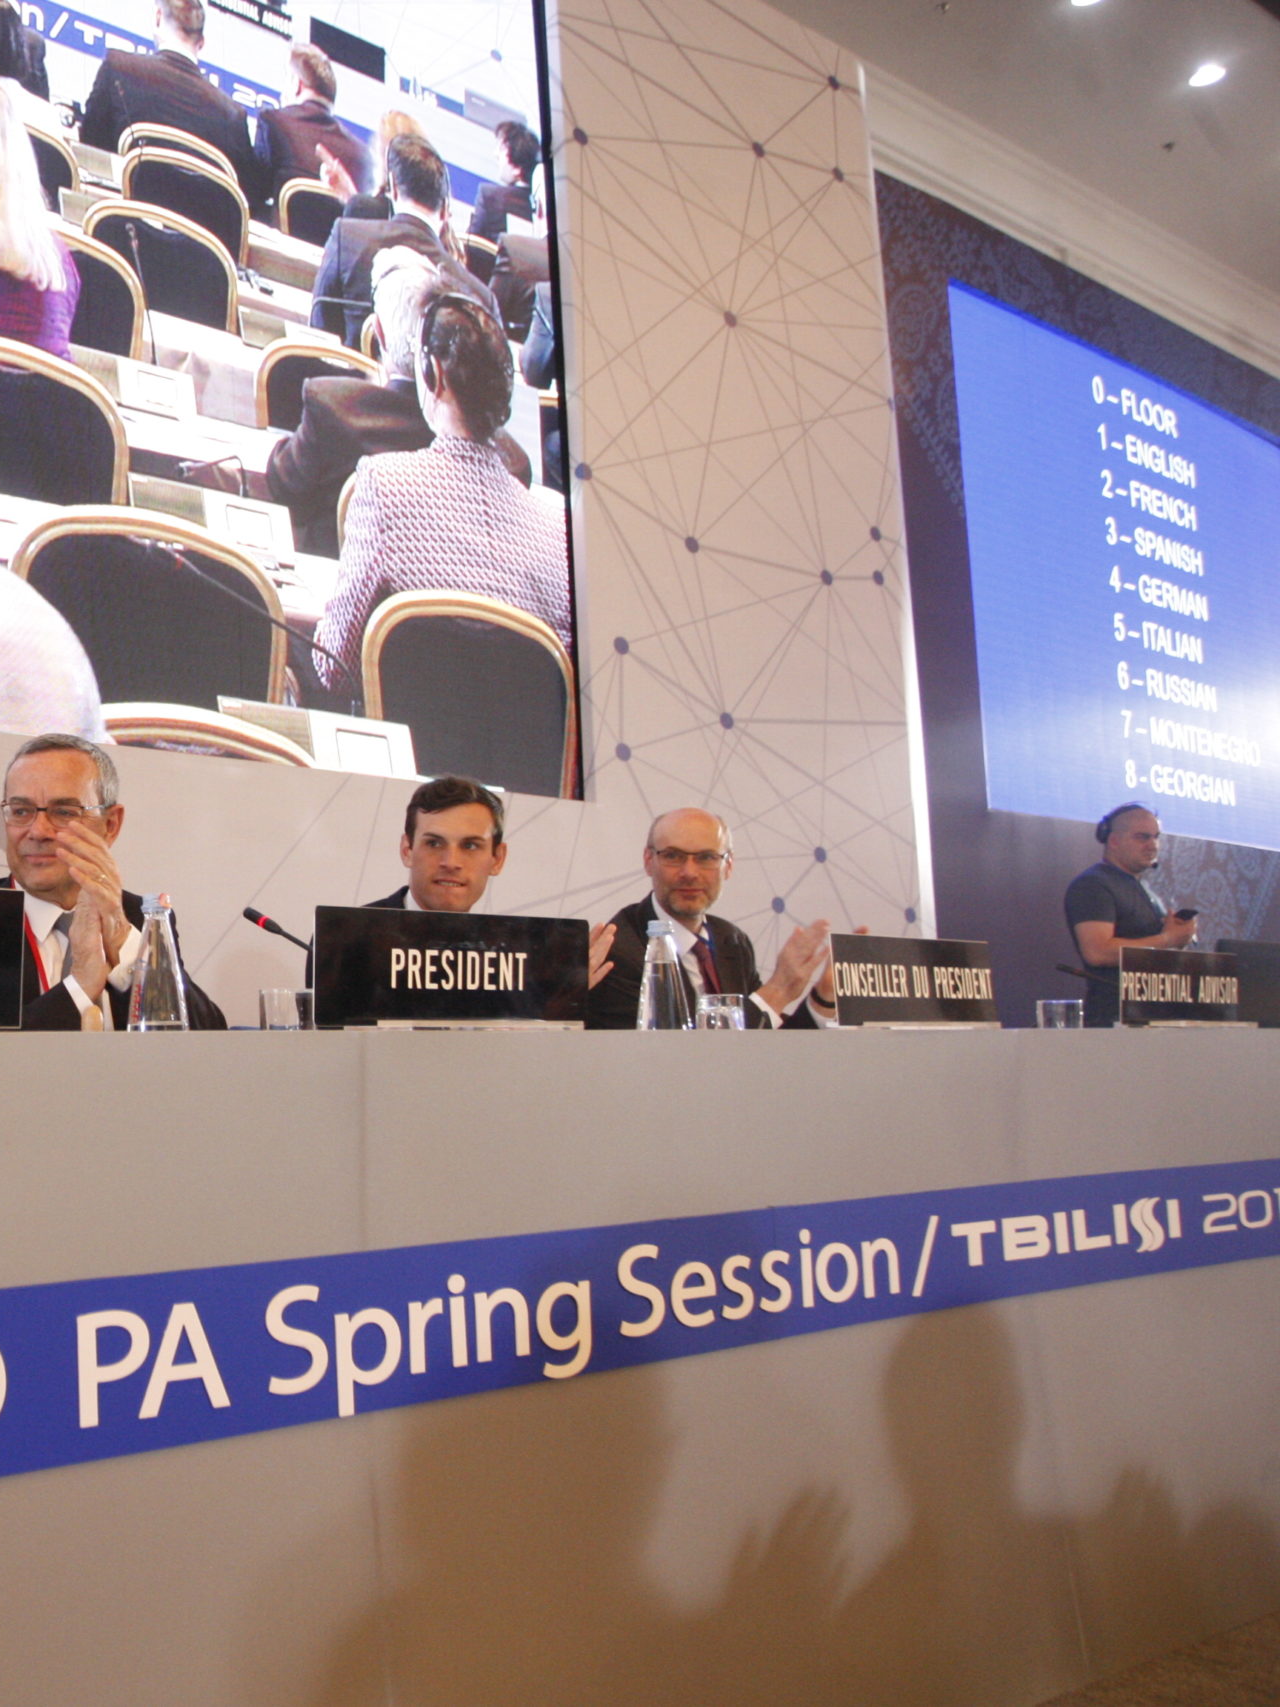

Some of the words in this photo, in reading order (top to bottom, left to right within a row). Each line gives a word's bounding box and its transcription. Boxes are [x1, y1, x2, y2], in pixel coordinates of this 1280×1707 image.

[1121, 388, 1178, 439] FLOOR
[1125, 434, 1196, 489] ENGLISH
[1129, 480, 1198, 532] FRENCH
[1134, 527, 1204, 577] SPANISH
[1138, 574, 1209, 622] GERMAN
[1141, 620, 1204, 665] ITALIAN
[1145, 667, 1219, 713] RUSSIAN
[1150, 716, 1262, 768] MONTENEGRO
[1150, 764, 1237, 807] GEORGIAN
[391, 948, 528, 992] PRESIDENT
[834, 961, 909, 998] CONSEILLER
[911, 965, 931, 999] DU
[933, 966, 993, 1000] PRESIDENT
[1122, 971, 1194, 1003] PRESIDENTIAL
[1198, 975, 1239, 1005] ADVISOR
[76, 1302, 232, 1430] PA
[265, 1273, 593, 1419] Spring
